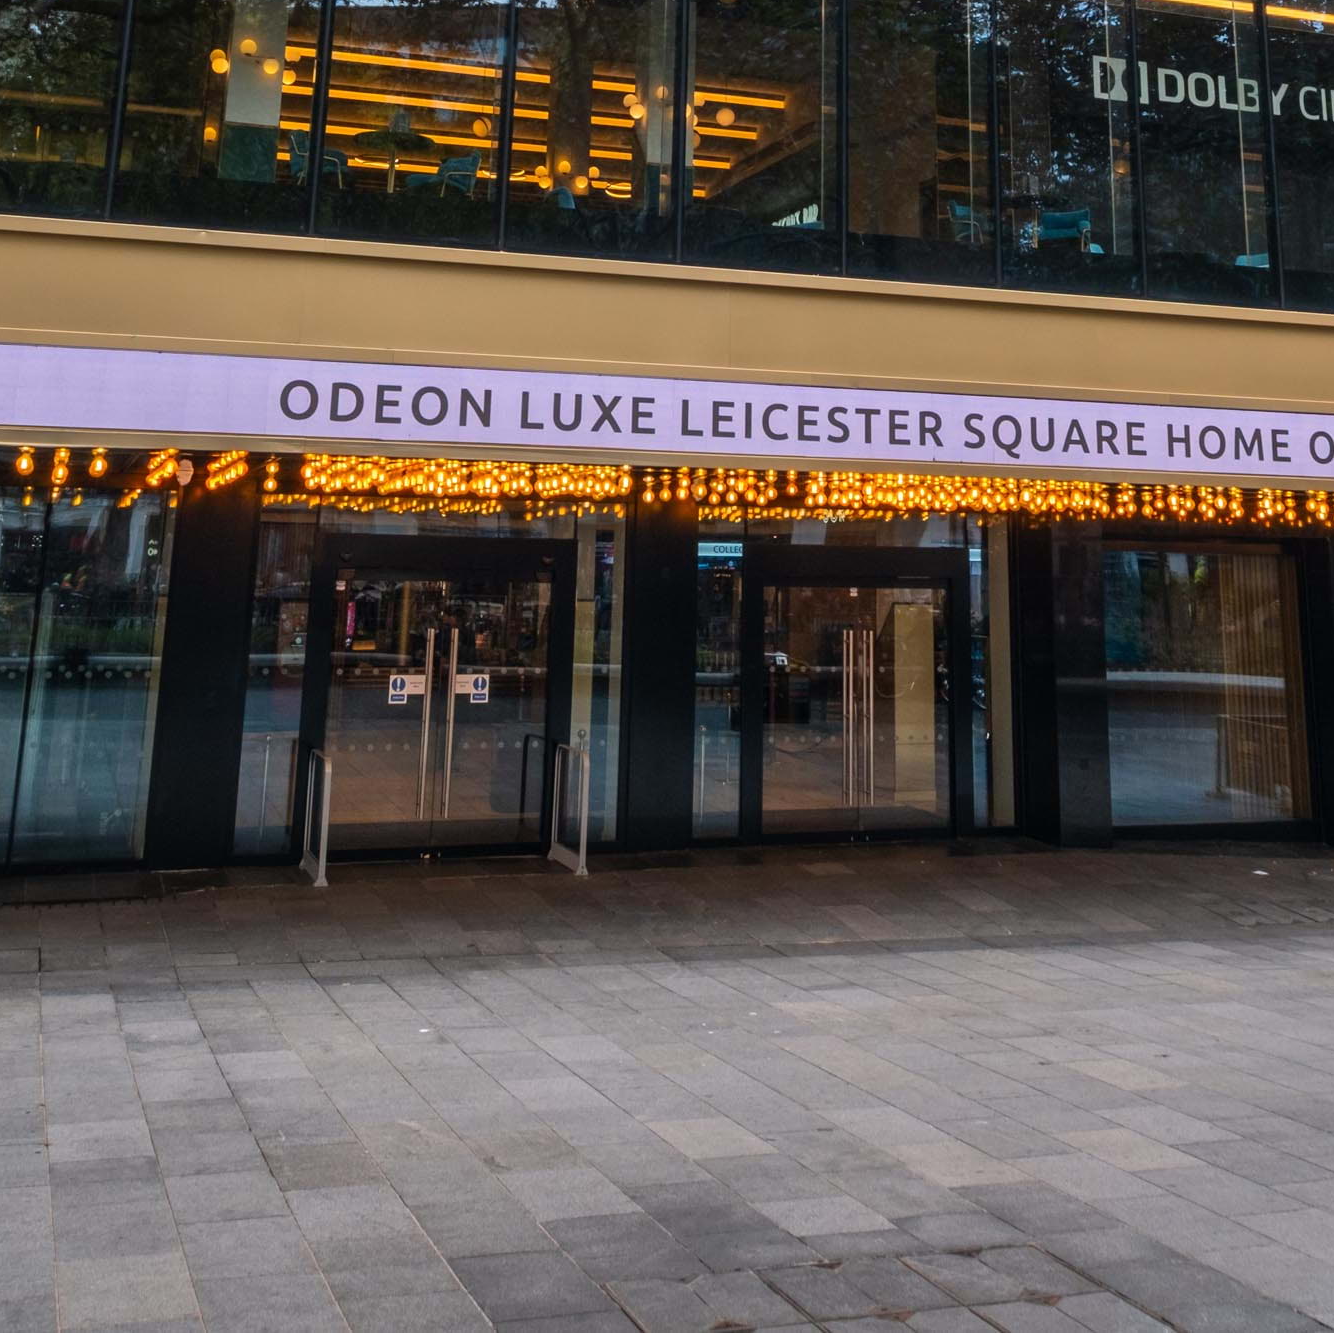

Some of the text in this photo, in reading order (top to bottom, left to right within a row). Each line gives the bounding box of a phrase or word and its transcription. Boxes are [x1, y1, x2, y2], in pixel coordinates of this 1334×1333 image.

[1157, 68, 1289, 116] DOLBY
[280, 379, 494, 429] ODEON
[520, 391, 656, 435] LUXE
[681, 401, 944, 447] LEICESTER
[963, 412, 1146, 458] SQUARE
[1167, 424, 1292, 463] HOME
